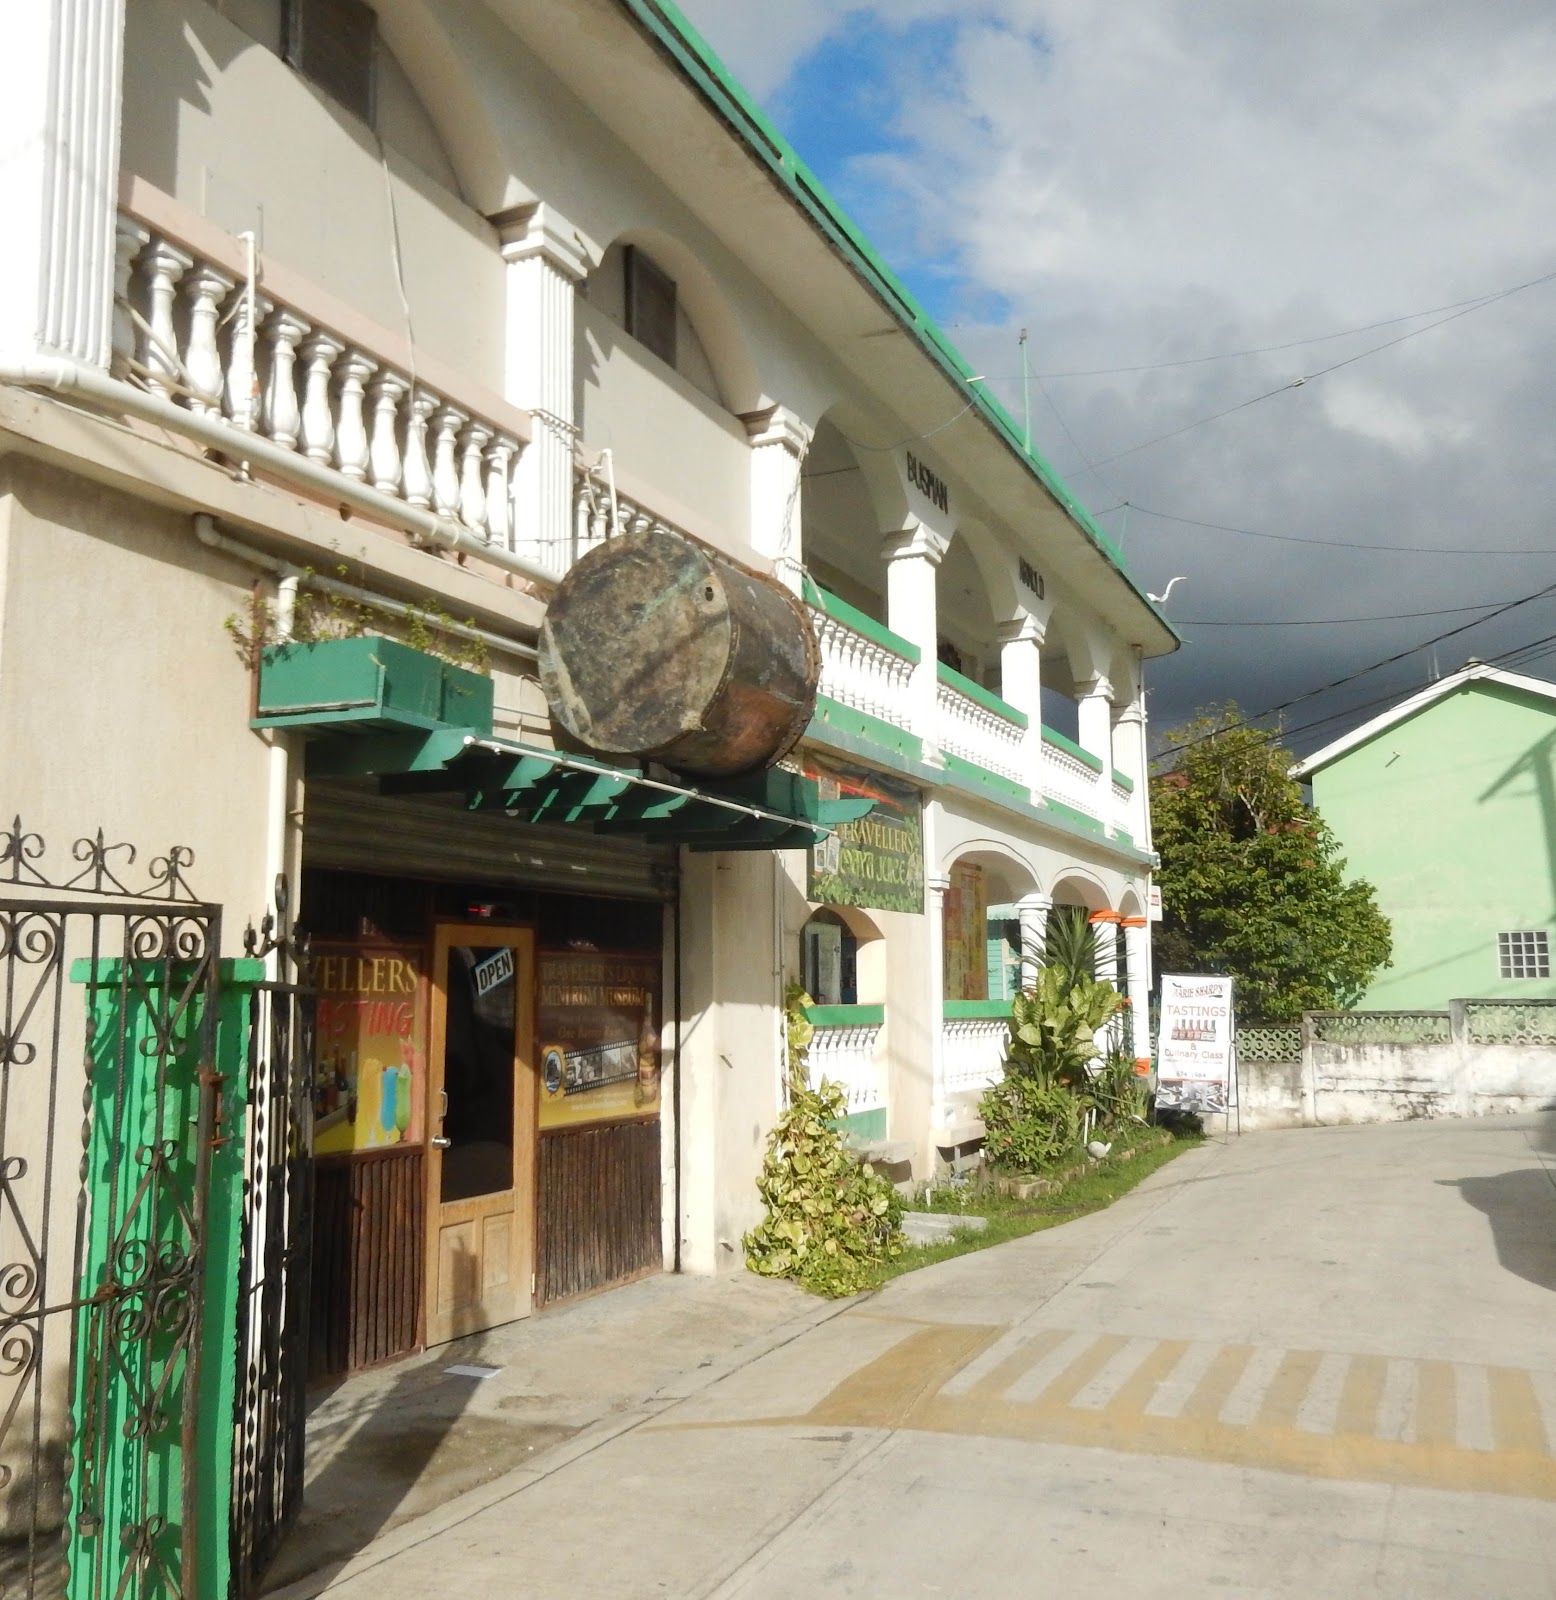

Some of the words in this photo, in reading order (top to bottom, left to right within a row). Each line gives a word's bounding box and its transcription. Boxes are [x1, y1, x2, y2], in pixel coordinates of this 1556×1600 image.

[478, 954, 513, 989] OPEN
[1166, 1004, 1227, 1018] TASTINGS
[1190, 1043, 1197, 1051] &
[1164, 1049, 1199, 1060] Culinary
[1201, 1050, 1224, 1060] Class
